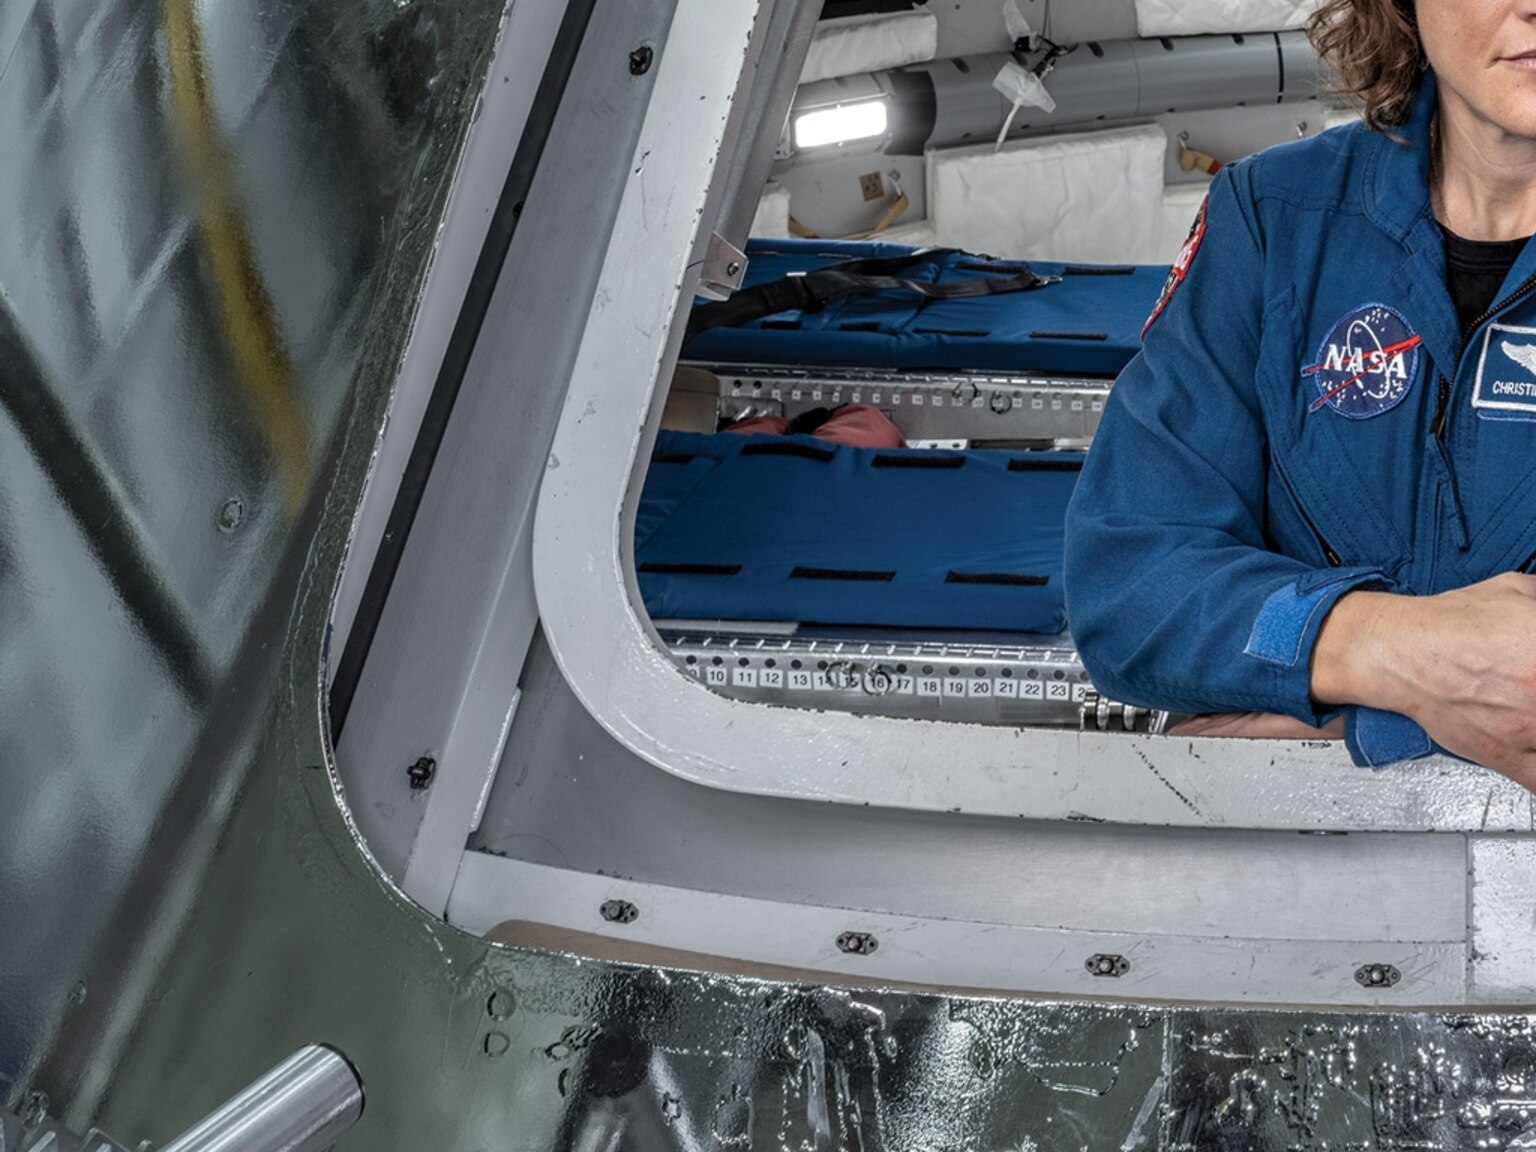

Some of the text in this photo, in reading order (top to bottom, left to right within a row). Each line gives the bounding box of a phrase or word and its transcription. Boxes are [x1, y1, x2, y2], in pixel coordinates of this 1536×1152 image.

[1323, 343, 1407, 379] NASA
[710, 670, 724, 682] 10
[739, 672, 752, 683] 11
[765, 672, 780, 684] 12
[793, 674, 808, 686] 13
[870, 677, 885, 689] 16
[897, 678, 911, 689] 17
[923, 681, 937, 692] 18
[949, 682, 964, 693] 19
[973, 681, 989, 694] 20
[999, 681, 1013, 693] 21
[1025, 683, 1040, 695] 22
[1050, 684, 1066, 696] 23
